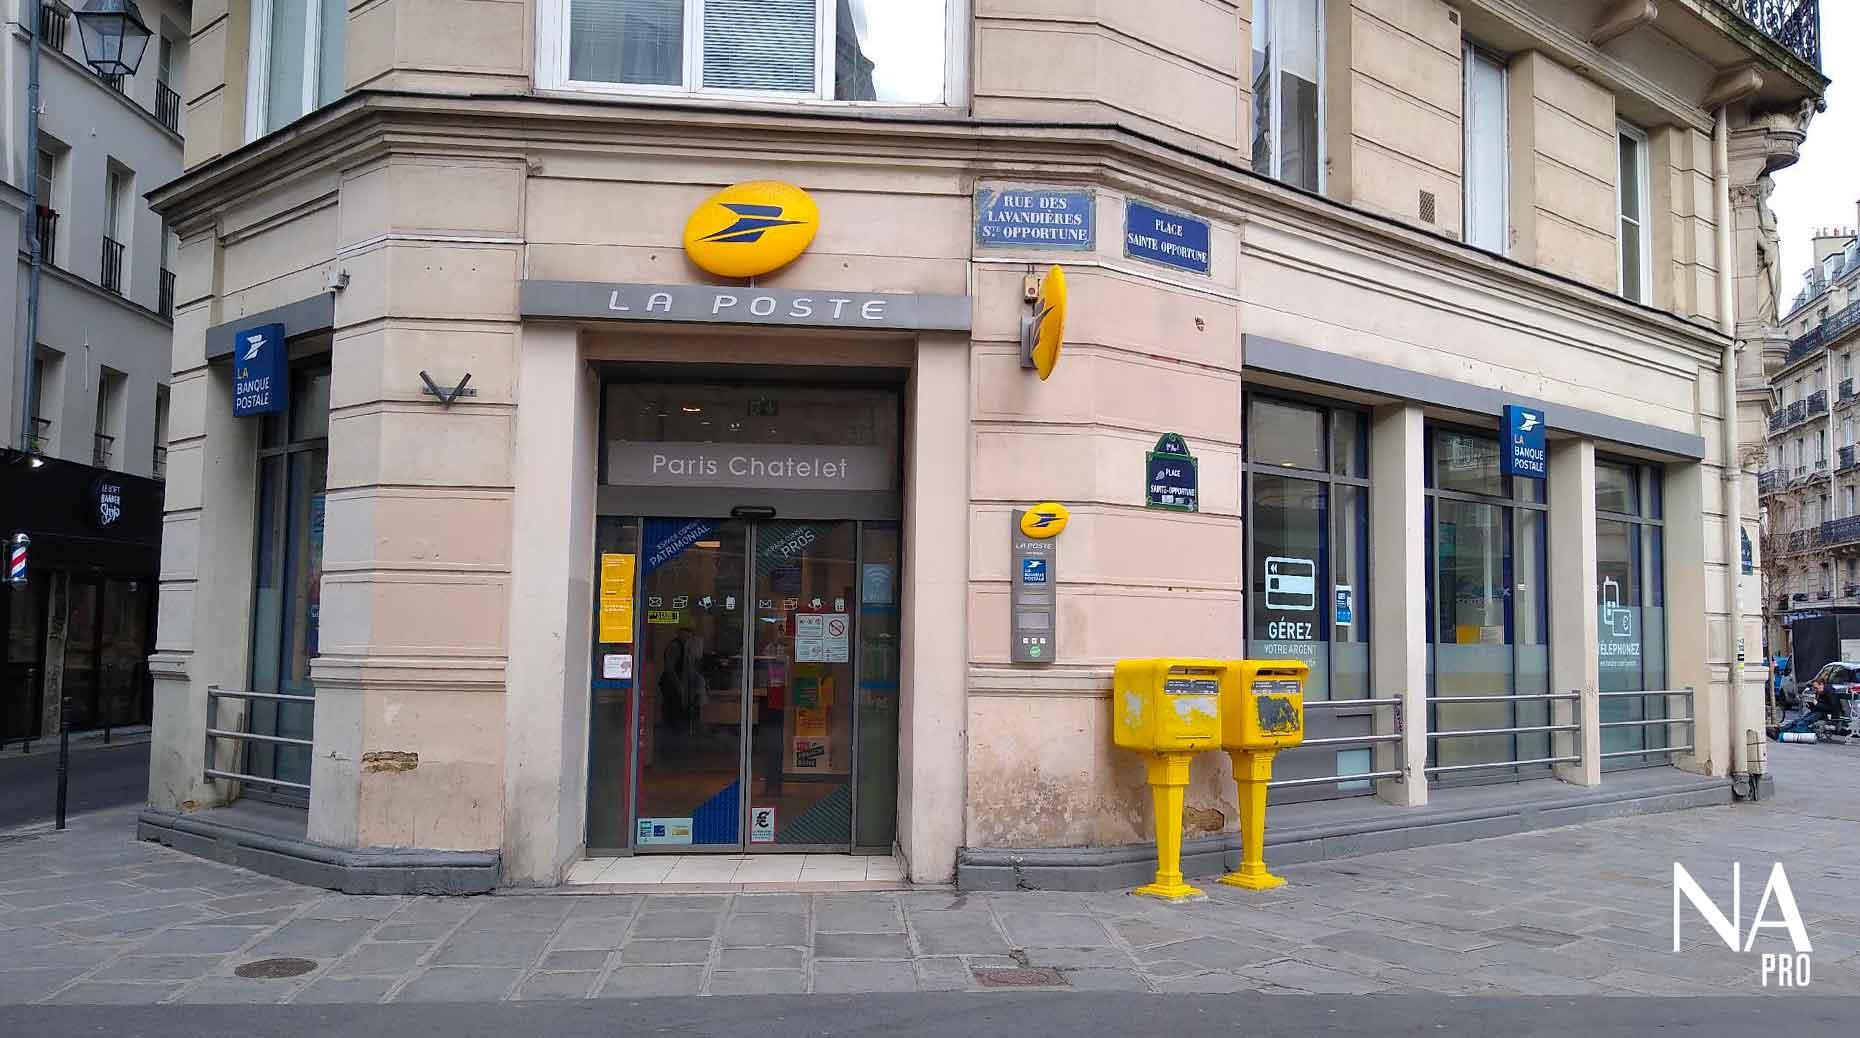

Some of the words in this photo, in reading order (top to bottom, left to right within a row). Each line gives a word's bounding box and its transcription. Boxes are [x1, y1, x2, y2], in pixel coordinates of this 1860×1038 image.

[1004, 195, 1033, 208] RUE
[1040, 197, 1067, 209] DES
[988, 209, 1082, 225] LAVANDIÈRES
[1003, 226, 1088, 241] OPPORTUNE
[1155, 218, 1183, 237] PLACE
[1128, 232, 1158, 251] SAINTE
[1160, 241, 1208, 264] OPPORTUNE
[608, 290, 673, 312] LA
[712, 295, 887, 320] POSTE
[237, 367, 249, 380] LA
[236, 376, 270, 395] BANQUE
[236, 392, 270, 410] POSTALE
[1514, 433, 1524, 446] LA
[1514, 446, 1544, 461] BANQUE
[653, 454, 718, 475] Paris
[729, 456, 848, 478] Chatelet
[1165, 467, 1181, 478] PLACE
[1514, 457, 1544, 473] POSTALE
[649, 525, 710, 567] PATRIMONIAL
[781, 530, 814, 558] PROS
[1269, 616, 1312, 640] GÉREZ
[1264, 643, 1288, 655] VOTRE
[1289, 644, 1318, 657] ARGENT
